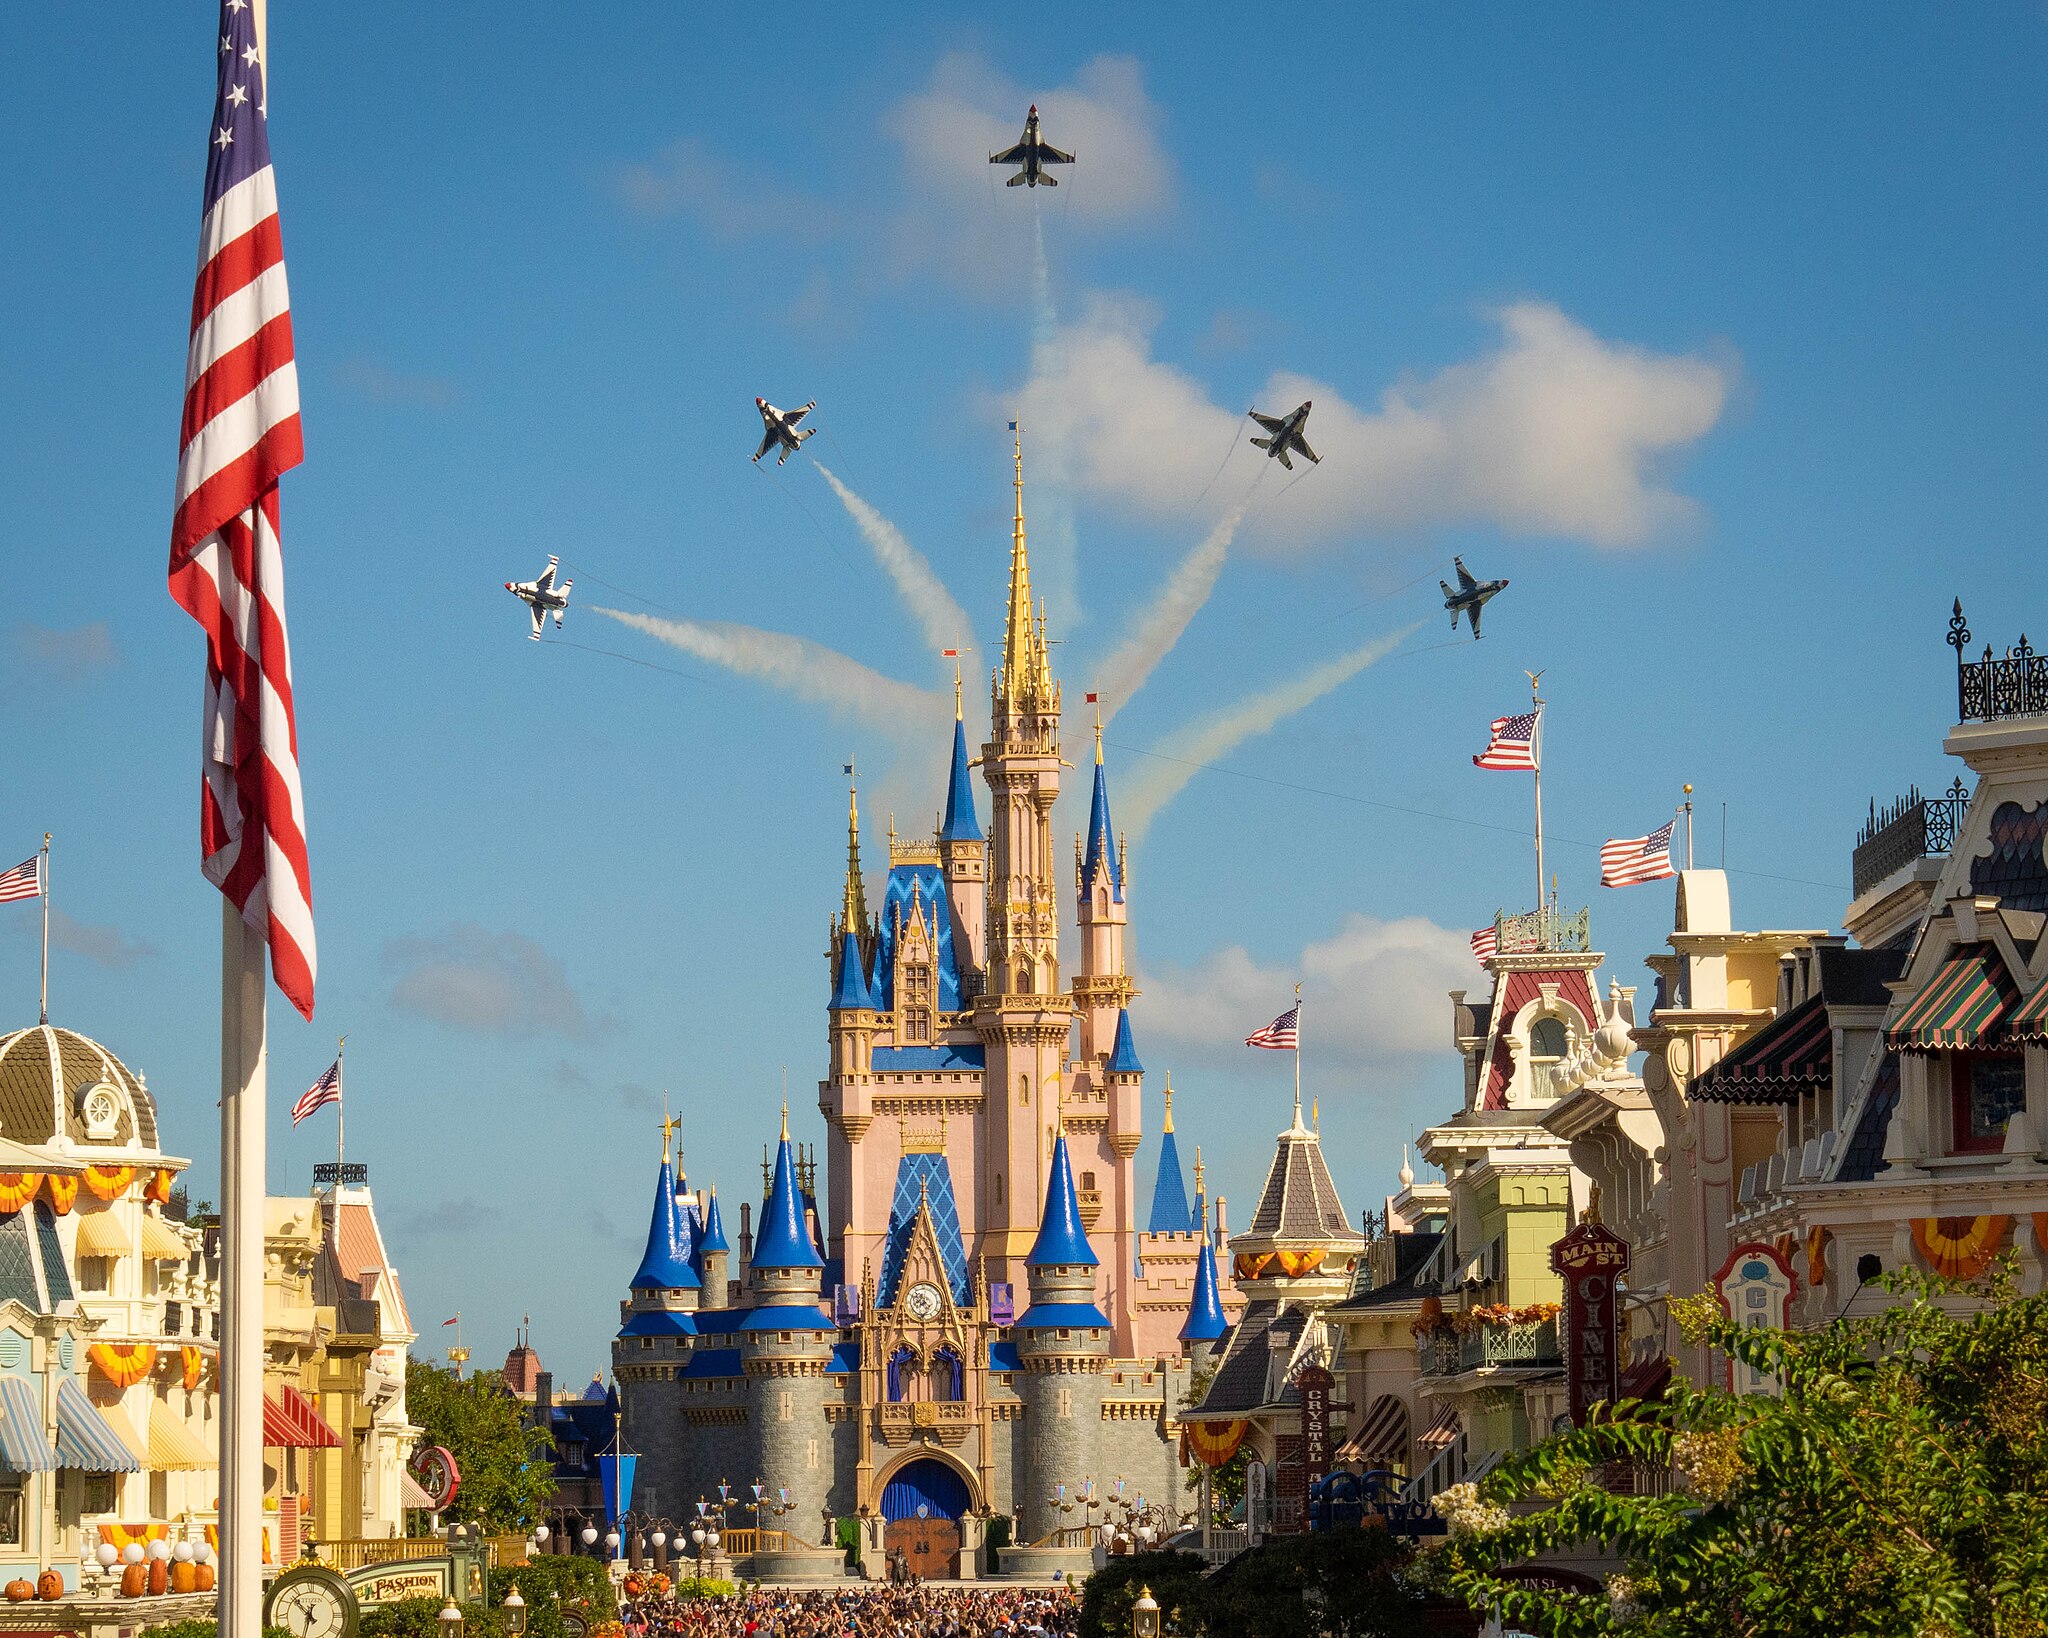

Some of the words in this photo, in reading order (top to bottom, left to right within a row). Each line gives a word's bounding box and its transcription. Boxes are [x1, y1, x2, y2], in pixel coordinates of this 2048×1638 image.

[1561, 1242, 1618, 1263] MAIN
[1596, 1253, 1625, 1265] ST.
[1578, 1274, 1611, 1408] CINEM
[1308, 1390, 1323, 1462] CRYSTAL
[373, 1576, 437, 1600] FASHION
